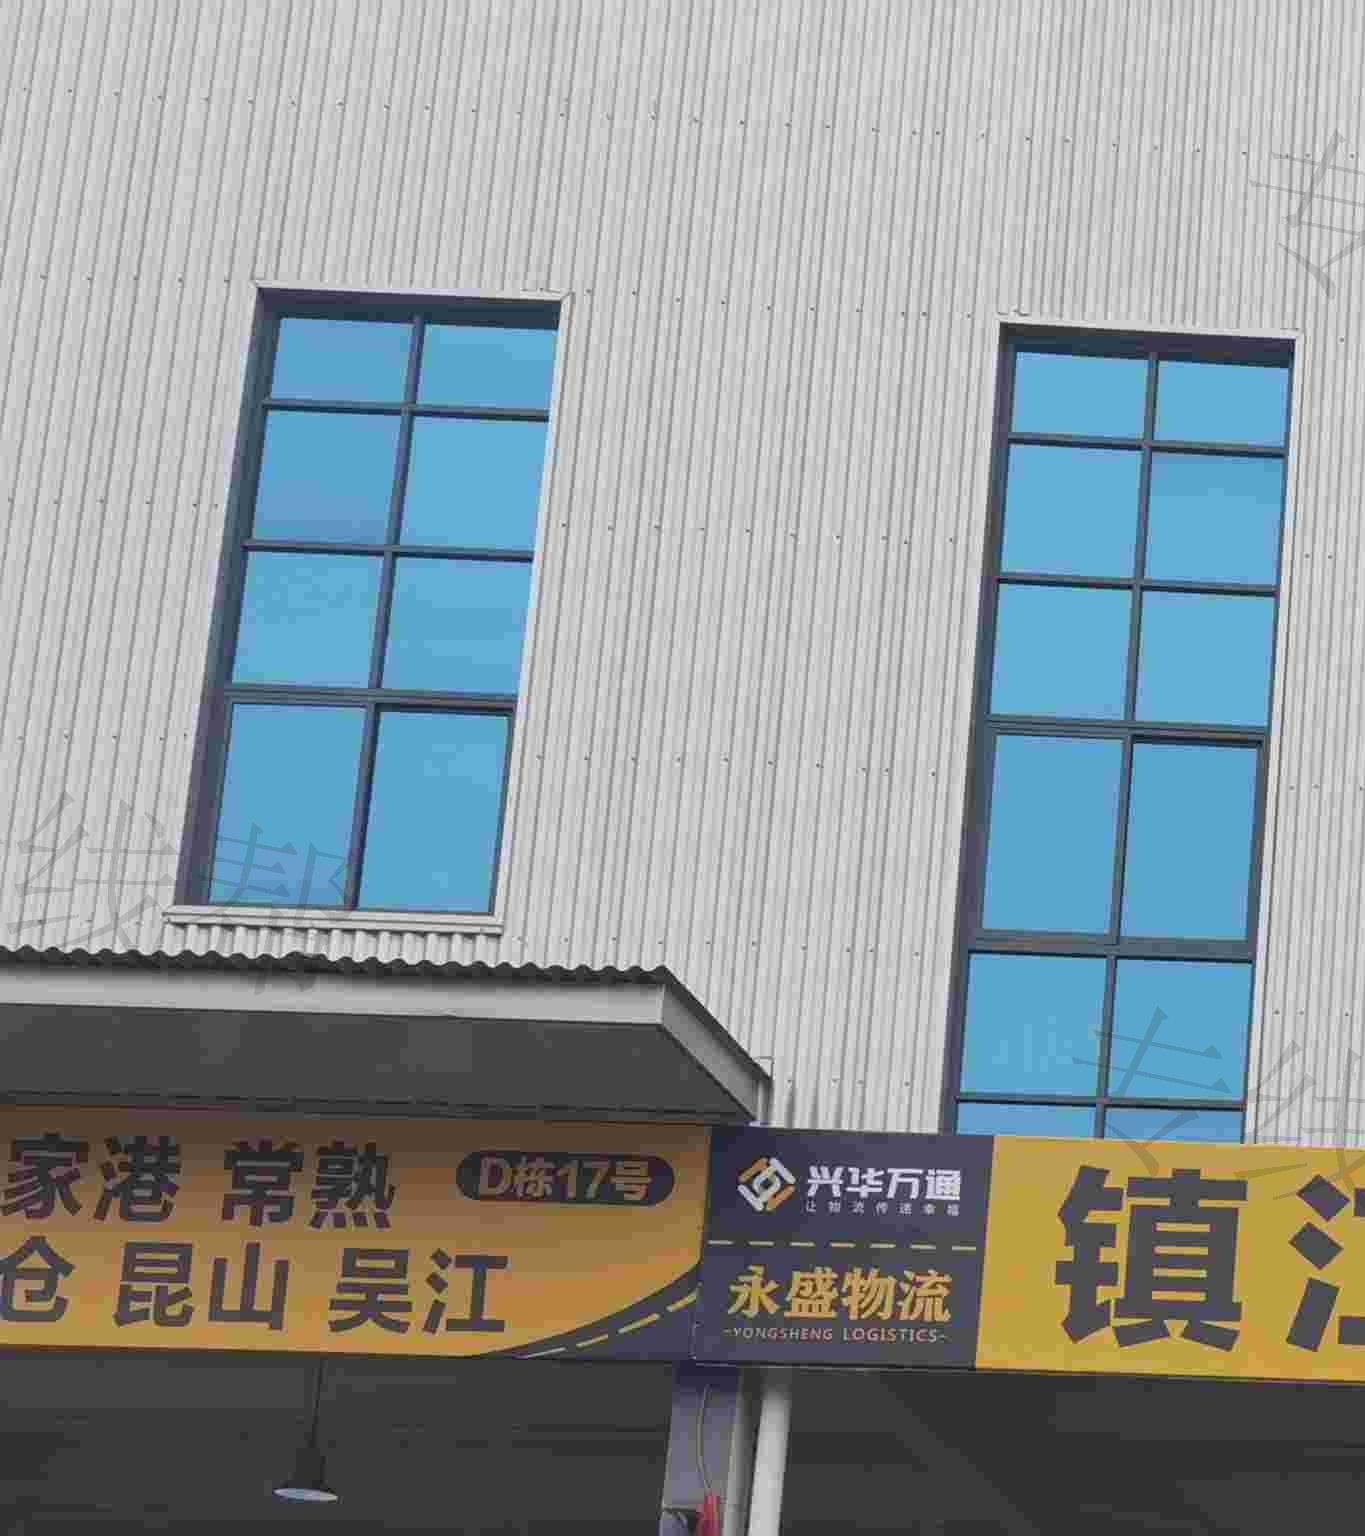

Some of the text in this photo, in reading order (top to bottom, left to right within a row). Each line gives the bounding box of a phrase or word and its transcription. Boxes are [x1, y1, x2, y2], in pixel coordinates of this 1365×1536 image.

[3, 1132, 396, 1229] 家港 常熟
[479, 1155, 652, 1201] D栋17号
[807, 1165, 962, 1201] 兴华万通
[112, 1240, 290, 1331] 昆山
[328, 1246, 509, 1334] 吴江
[727, 1265, 952, 1322] 永盛物流
[732, 1326, 938, 1344] YONGSHENG LOGISTICS
